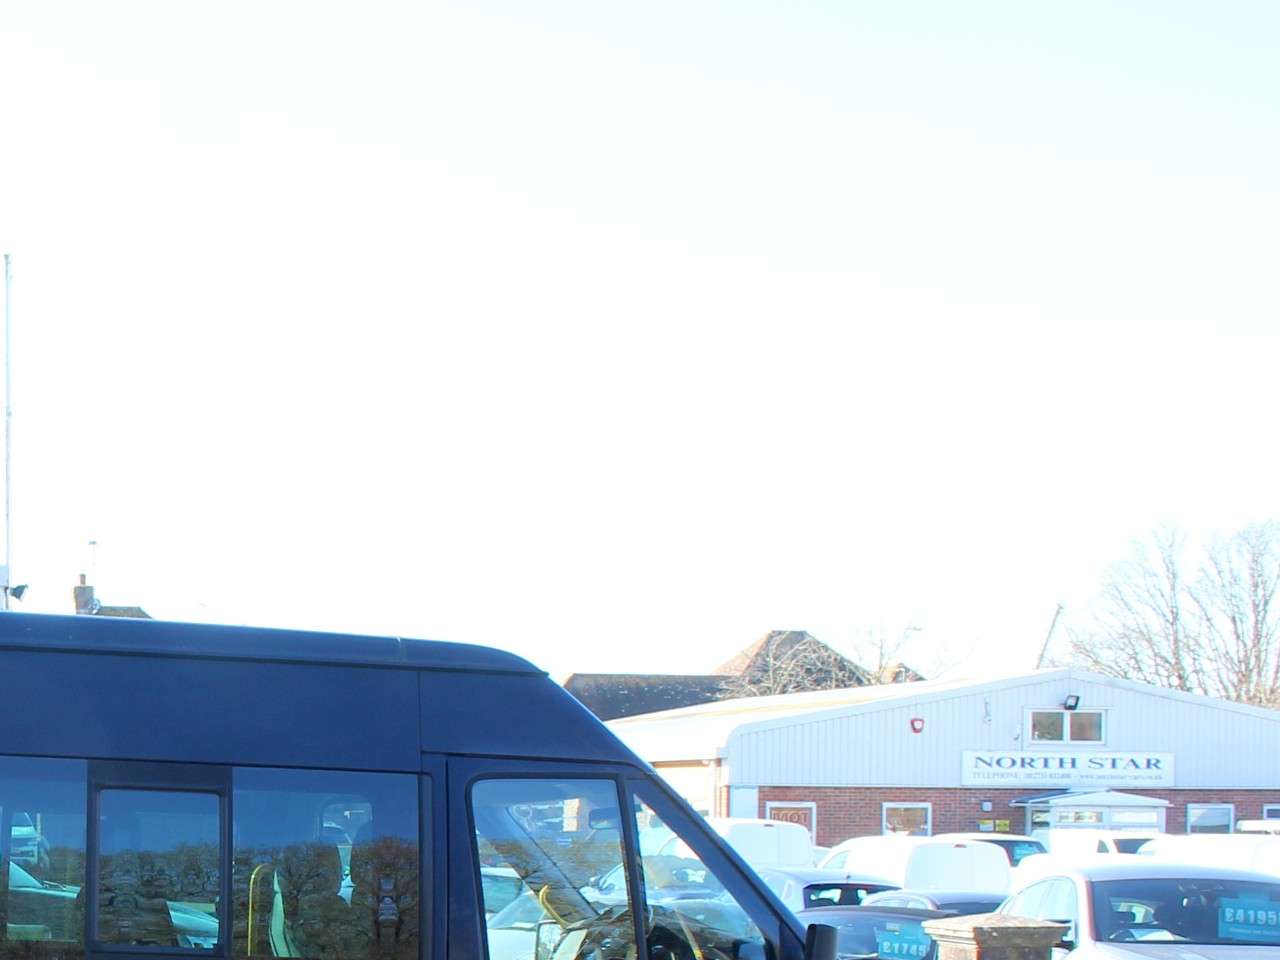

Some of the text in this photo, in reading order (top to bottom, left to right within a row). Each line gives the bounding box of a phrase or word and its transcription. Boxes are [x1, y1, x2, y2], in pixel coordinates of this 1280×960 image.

[975, 756, 1161, 769] NORTH STAR
[1224, 907, 1280, 926] £4195
